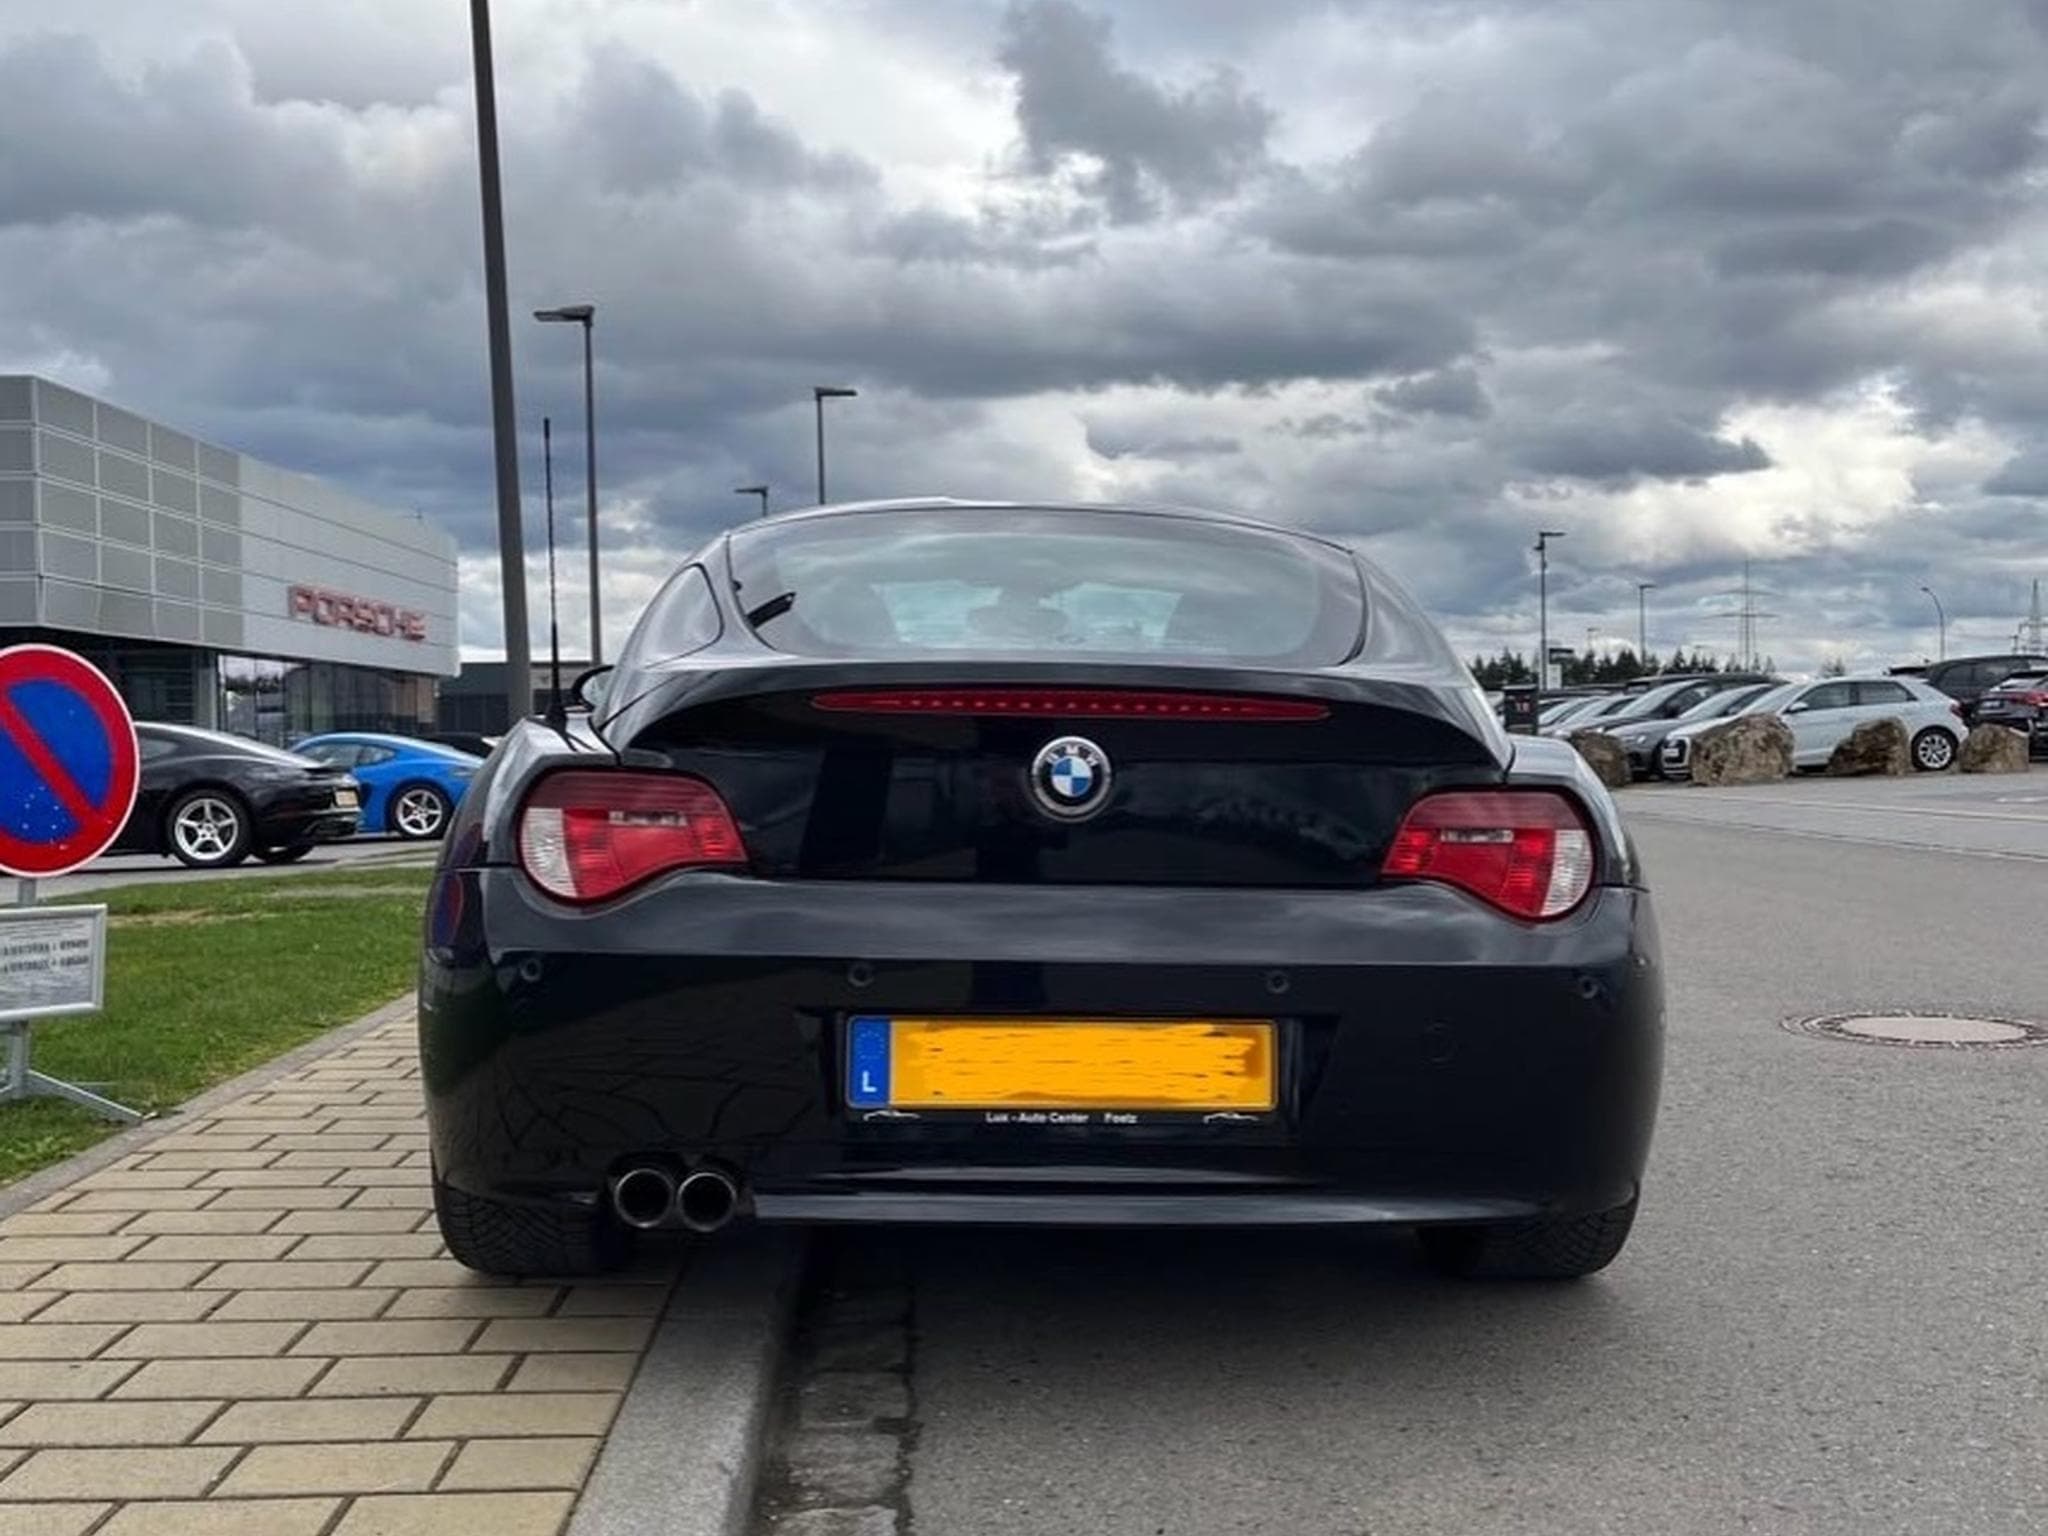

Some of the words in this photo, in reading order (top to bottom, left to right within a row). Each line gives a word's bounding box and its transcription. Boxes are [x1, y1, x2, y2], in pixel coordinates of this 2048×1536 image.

[288, 585, 427, 641] PORSCHE
[1045, 743, 1099, 767] BMW
[862, 1070, 877, 1092] L
[1050, 1112, 1089, 1123] Center
